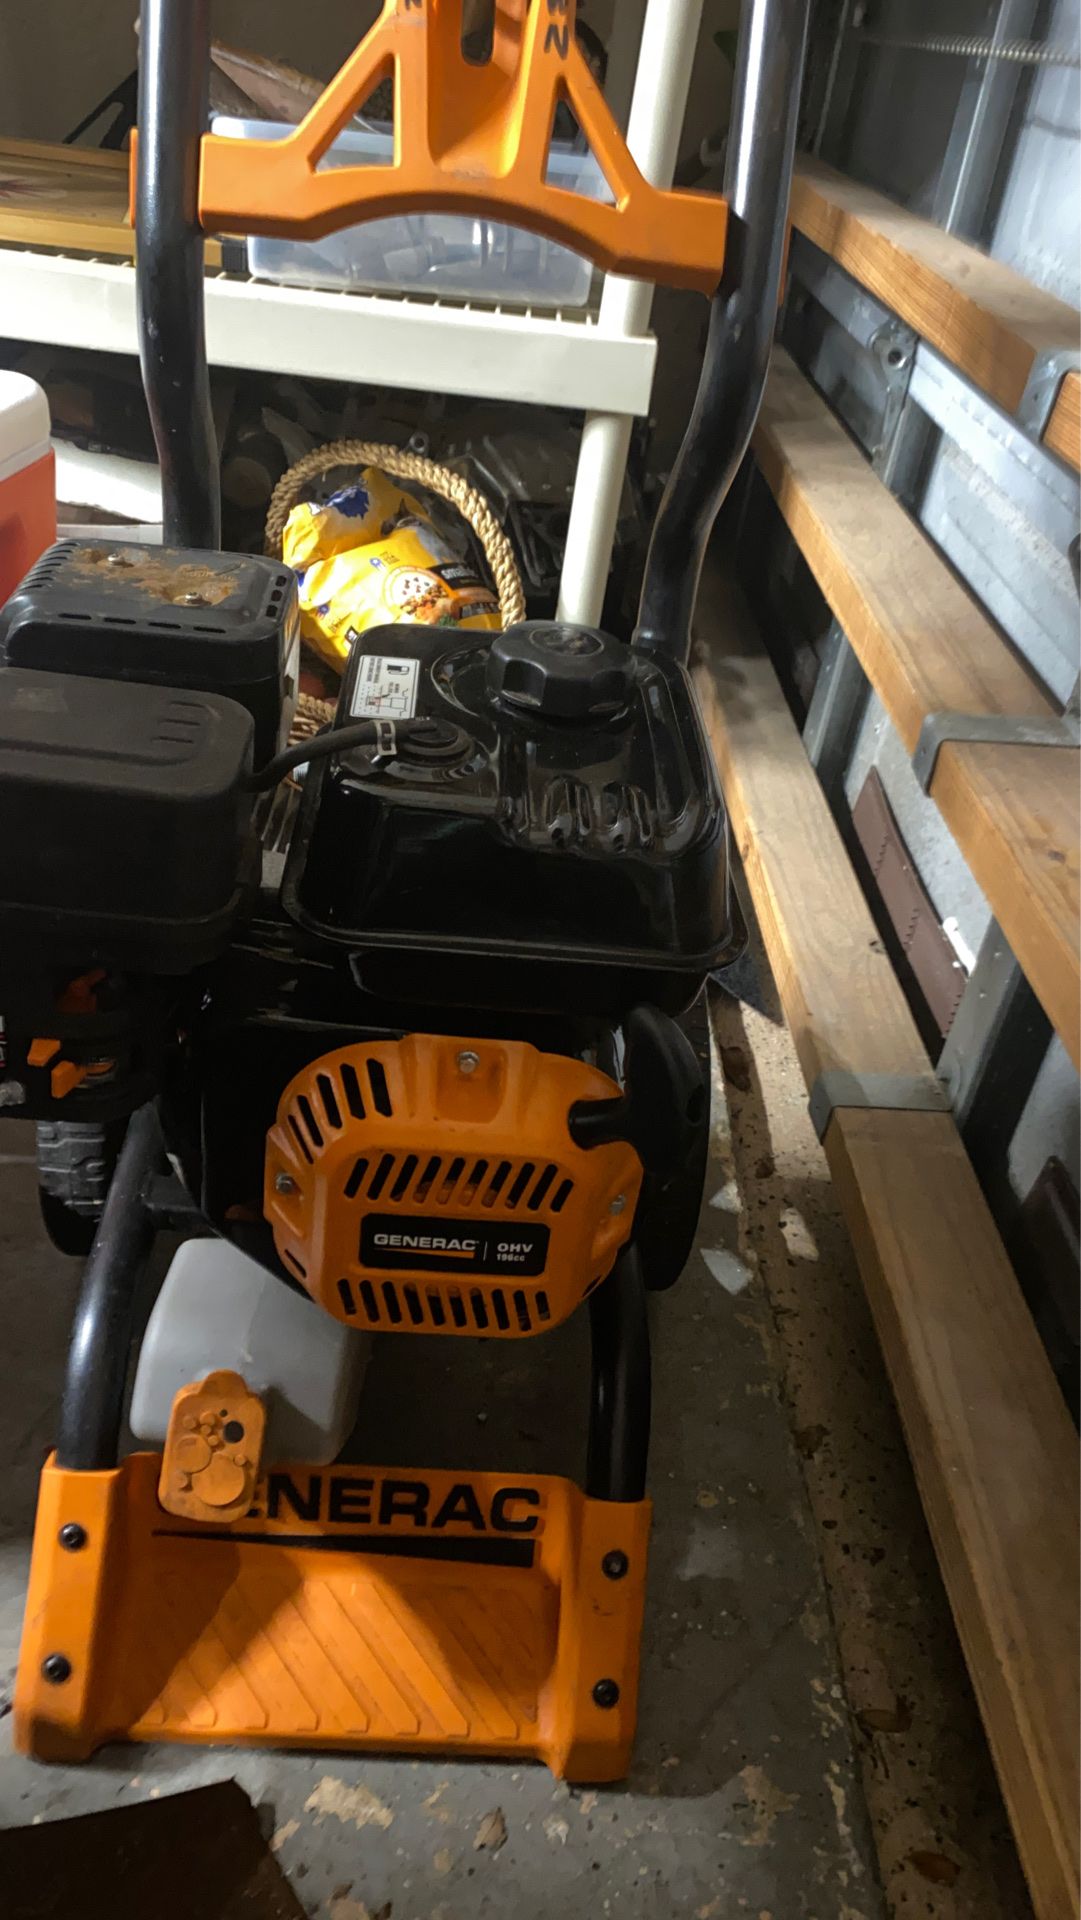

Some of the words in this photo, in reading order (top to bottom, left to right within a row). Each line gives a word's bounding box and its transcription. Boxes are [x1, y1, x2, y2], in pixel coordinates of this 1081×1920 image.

[374, 1233, 476, 1251] GENERAC
[497, 1242, 533, 1253] OHV
[496, 1253, 526, 1262] 196cc
[247, 1473, 540, 1533] NERAC
